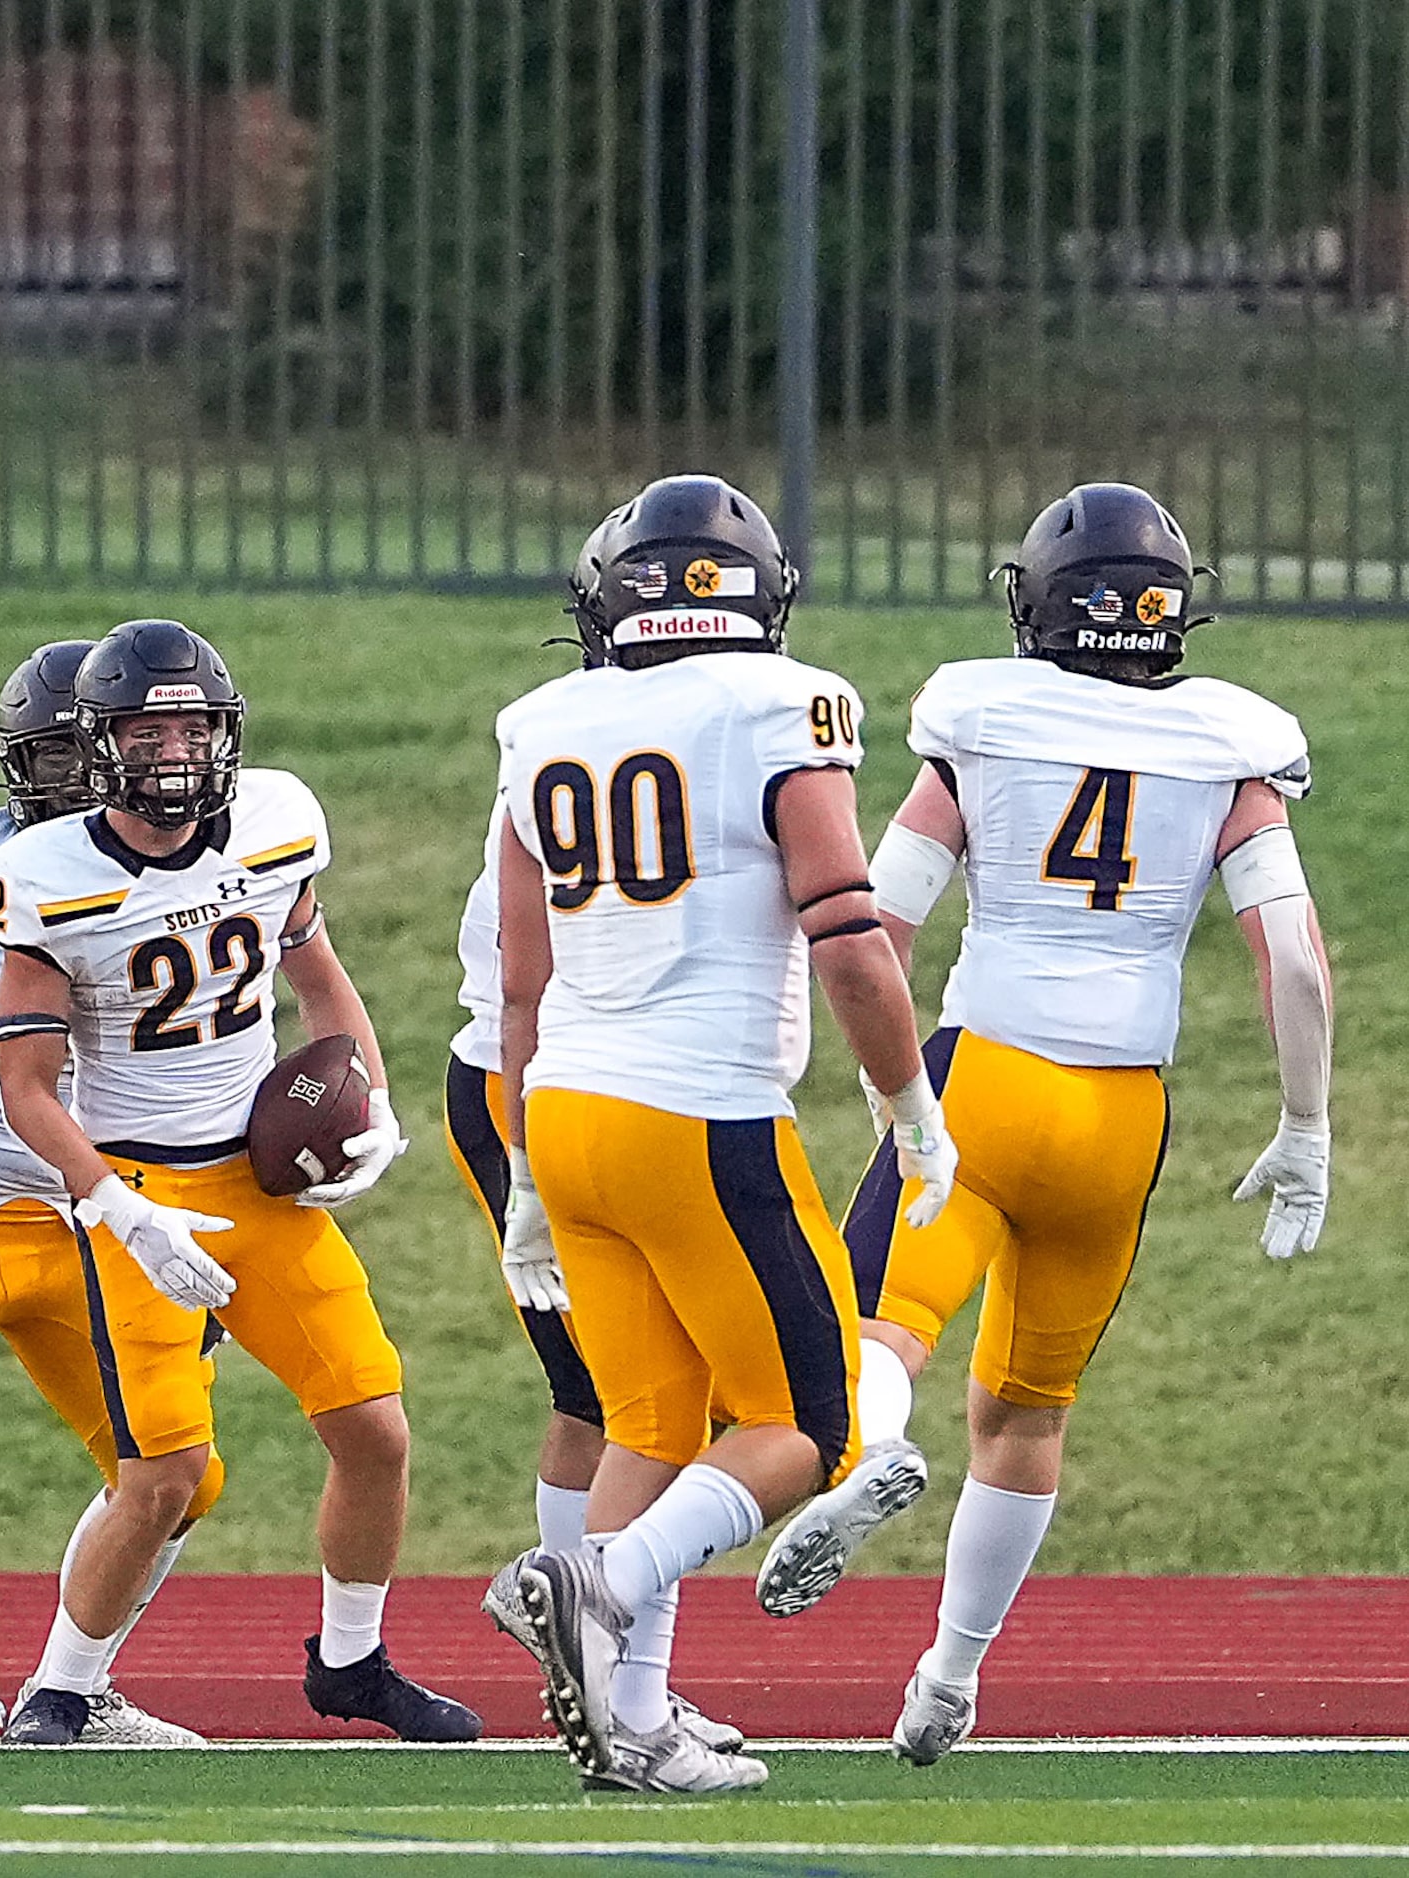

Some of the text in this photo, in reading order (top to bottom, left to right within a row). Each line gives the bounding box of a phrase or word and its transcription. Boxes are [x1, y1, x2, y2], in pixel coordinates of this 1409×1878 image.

[638, 616, 727, 637] Riddell
[1077, 629, 1167, 650] Riddell
[154, 688, 198, 699] Riddell
[808, 694, 854, 749] 90
[532, 747, 696, 914] 90
[1041, 767, 1137, 912] 4
[127, 912, 264, 1052] 22
